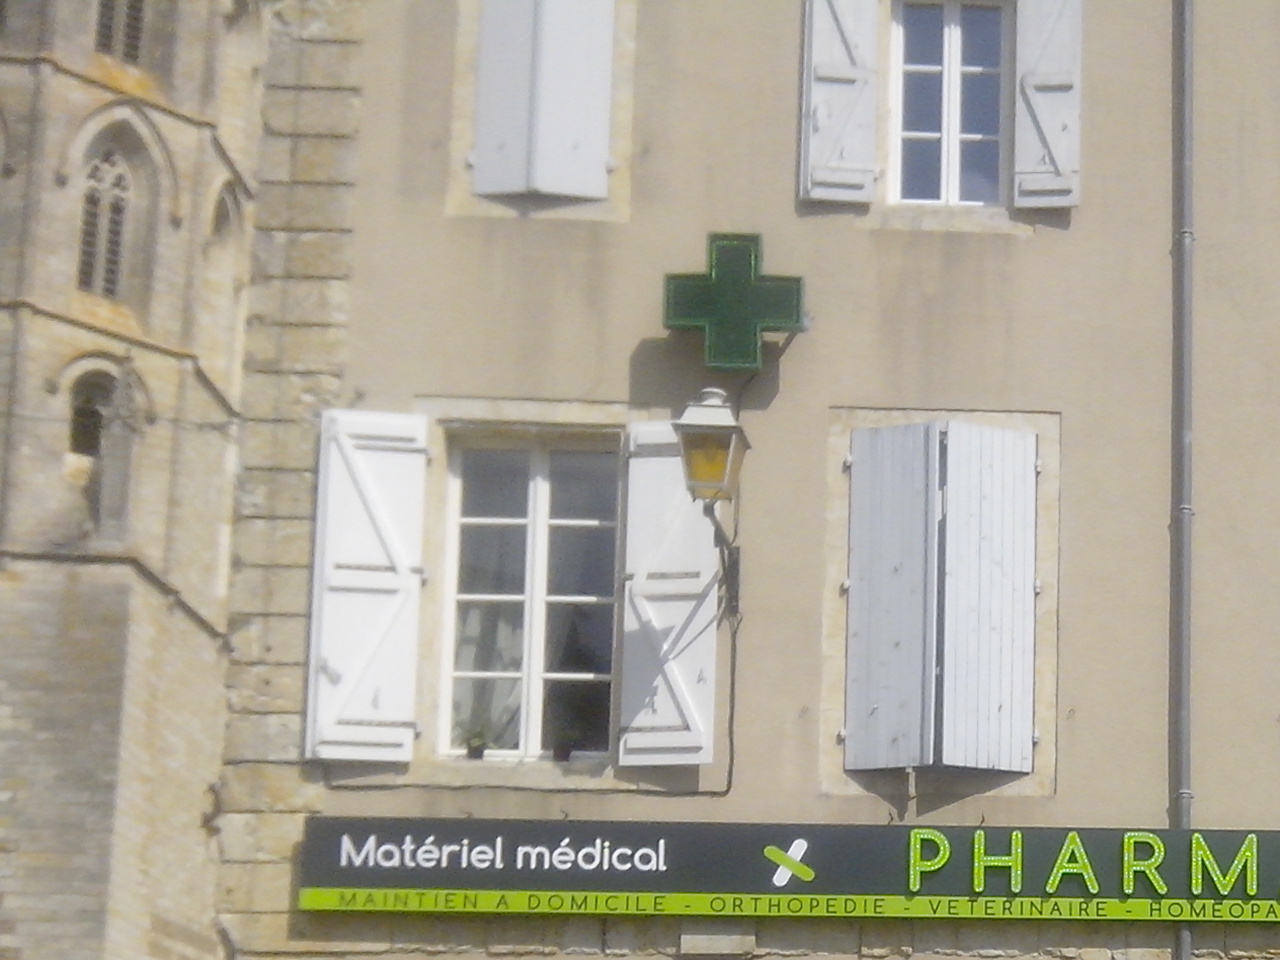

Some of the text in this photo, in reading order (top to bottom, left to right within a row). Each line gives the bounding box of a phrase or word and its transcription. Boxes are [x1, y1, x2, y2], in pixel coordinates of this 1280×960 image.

[339, 833, 668, 872] Matériel médical
[339, 891, 477, 909] MAINTIEN
[527, 895, 666, 913] DOMICILE
[709, 897, 886, 915] ORTHOPEDIE
[928, 899, 1108, 918] VETERINAIRE
